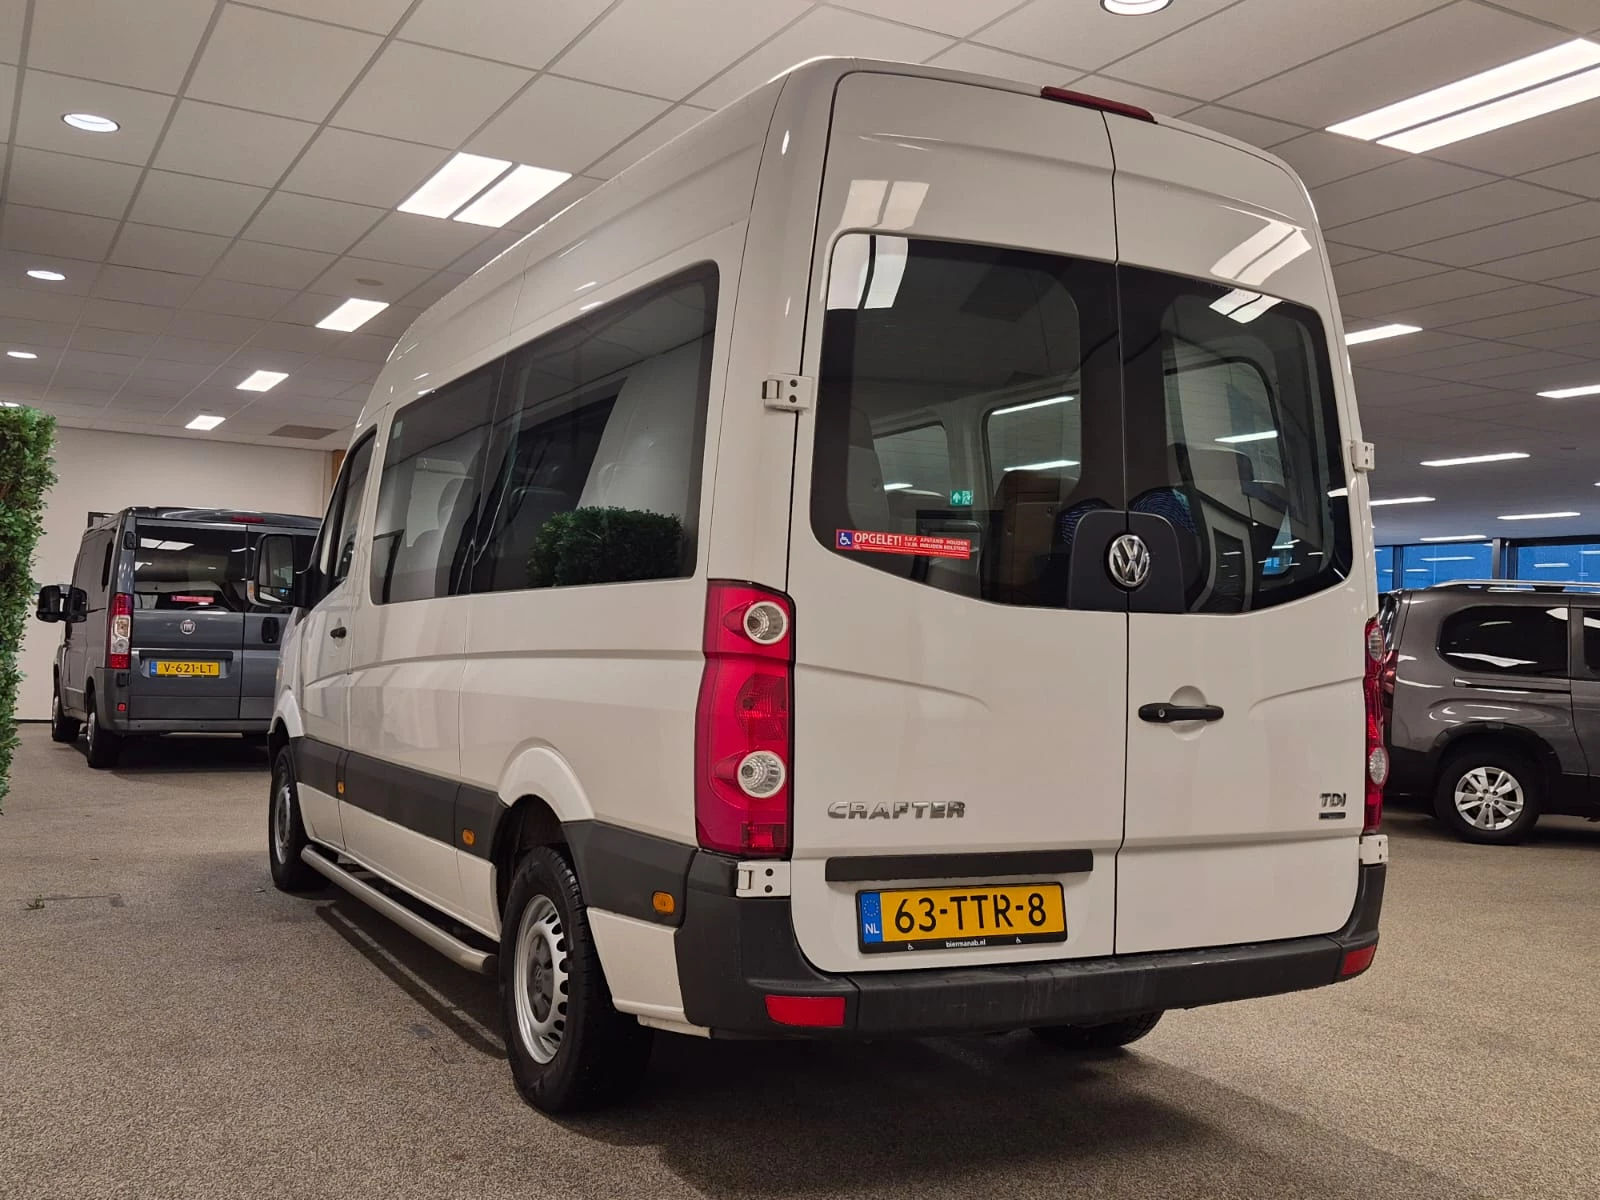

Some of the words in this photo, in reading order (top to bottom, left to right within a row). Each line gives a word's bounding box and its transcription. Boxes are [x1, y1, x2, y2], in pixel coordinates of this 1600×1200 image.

[854, 532, 901, 546] OPGELET!
[163, 663, 213, 674] V-621-LT
[1320, 792, 1347, 808] TDI
[827, 801, 966, 820] CRAFTER
[894, 892, 1047, 934] 63-TTR-8
[865, 922, 881, 935] NL
[945, 938, 986, 948] biermanab.nl
